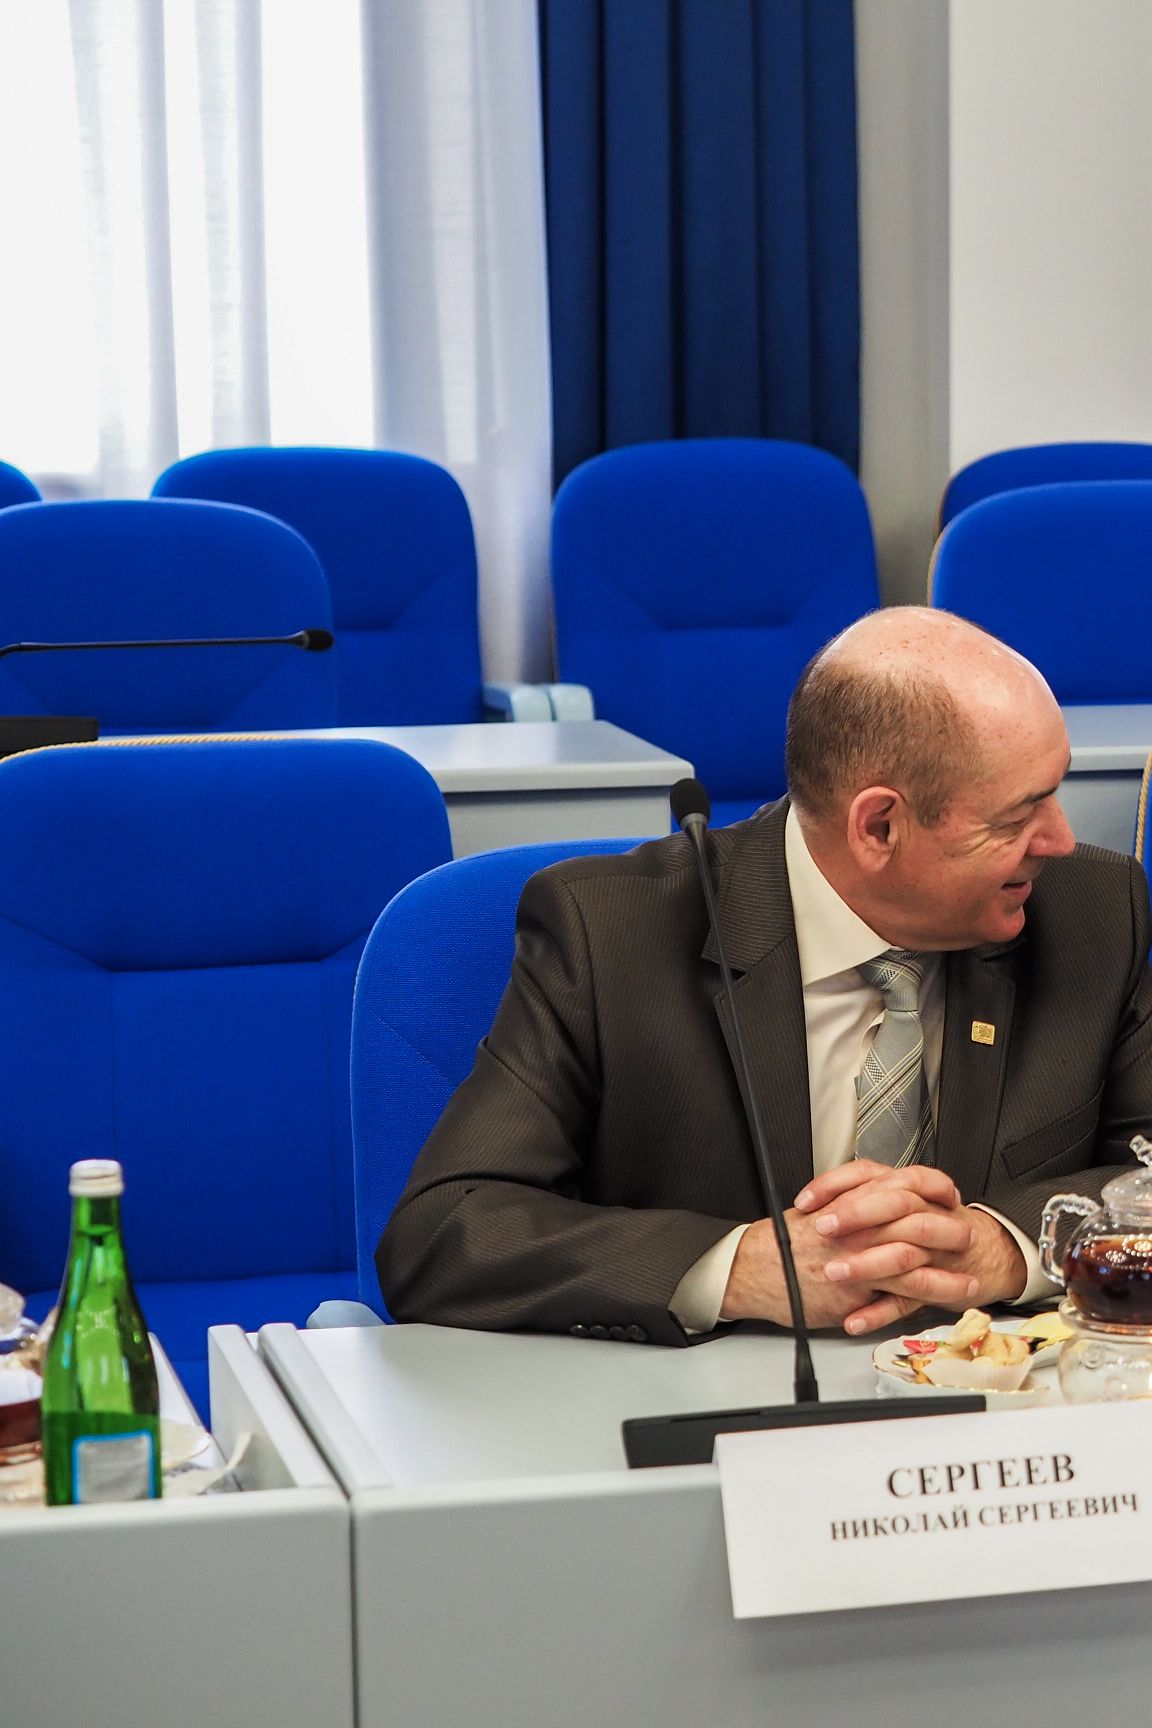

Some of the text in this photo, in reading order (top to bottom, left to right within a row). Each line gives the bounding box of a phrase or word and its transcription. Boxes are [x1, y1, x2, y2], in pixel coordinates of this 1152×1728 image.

[886, 1453, 1077, 1499] СЕРГЕЕВ
[830, 1493, 1140, 1541] НИКОЛАЙ СЕРГЕЕВИЧ
